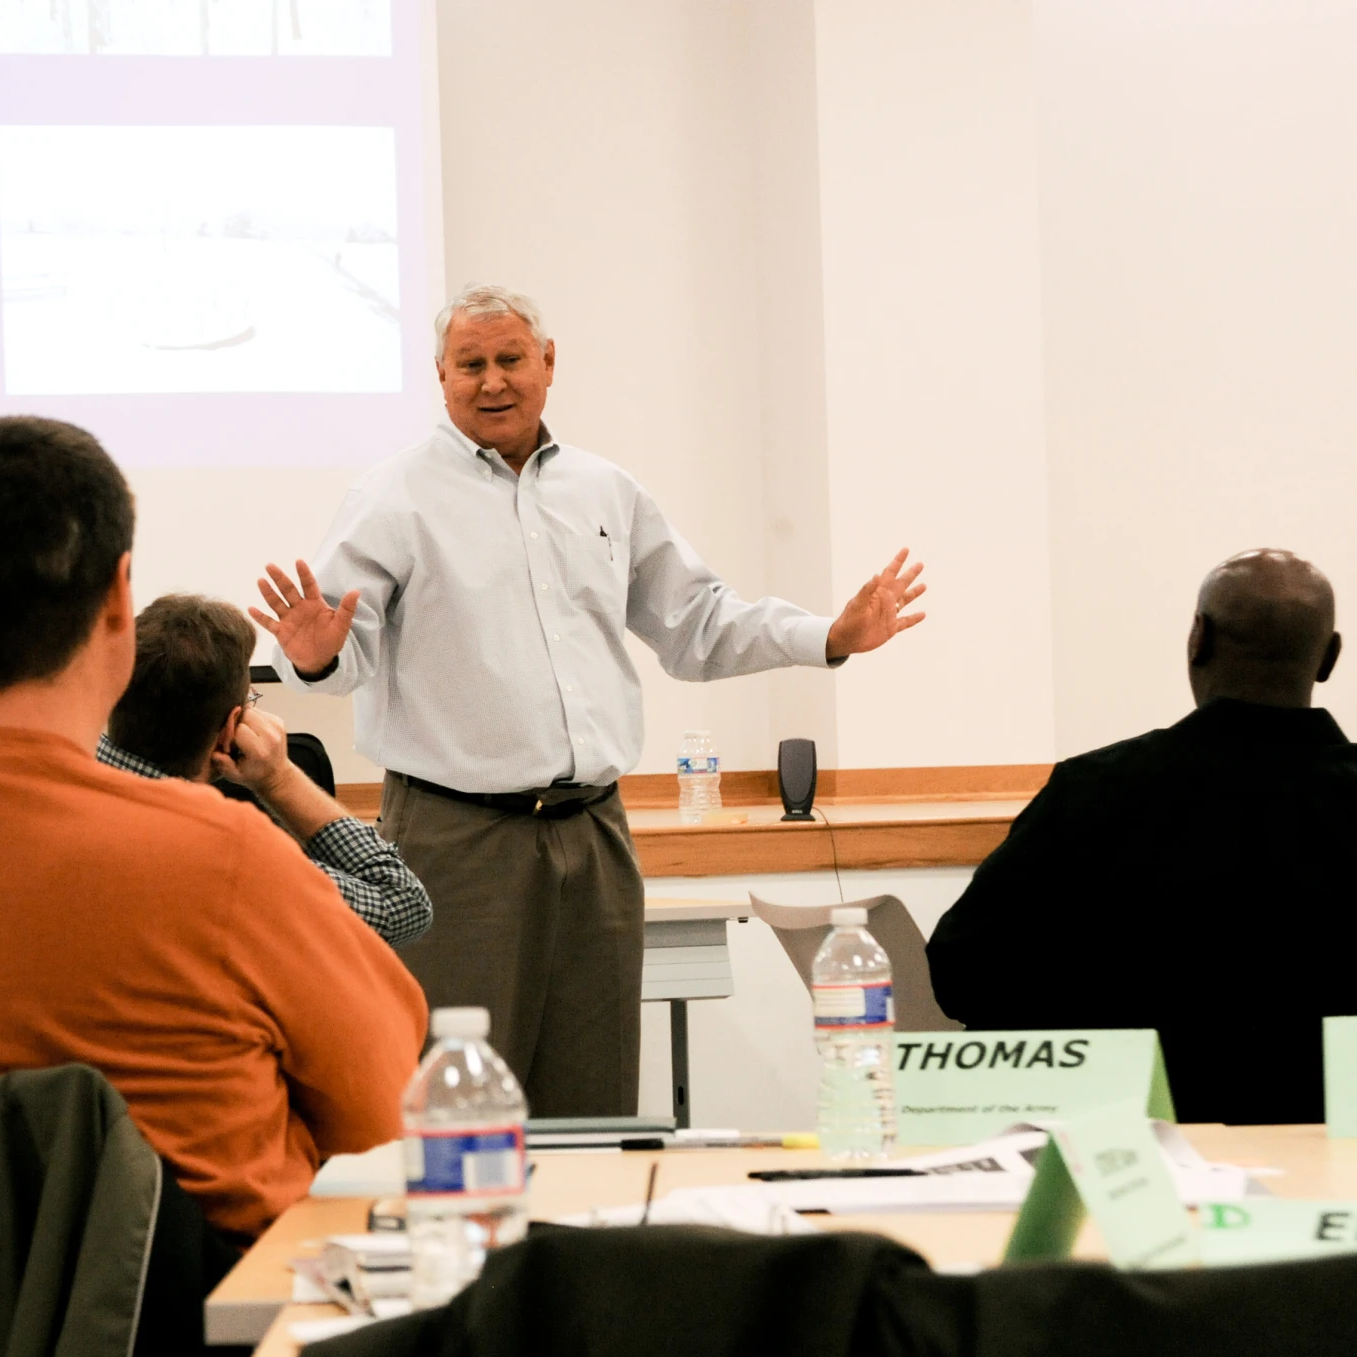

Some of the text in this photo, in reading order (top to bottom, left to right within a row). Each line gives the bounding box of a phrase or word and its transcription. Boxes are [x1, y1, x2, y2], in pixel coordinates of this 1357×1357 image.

[896, 1039, 1090, 1071] THOMAS
[901, 1104, 1058, 1115] Department of the Army
